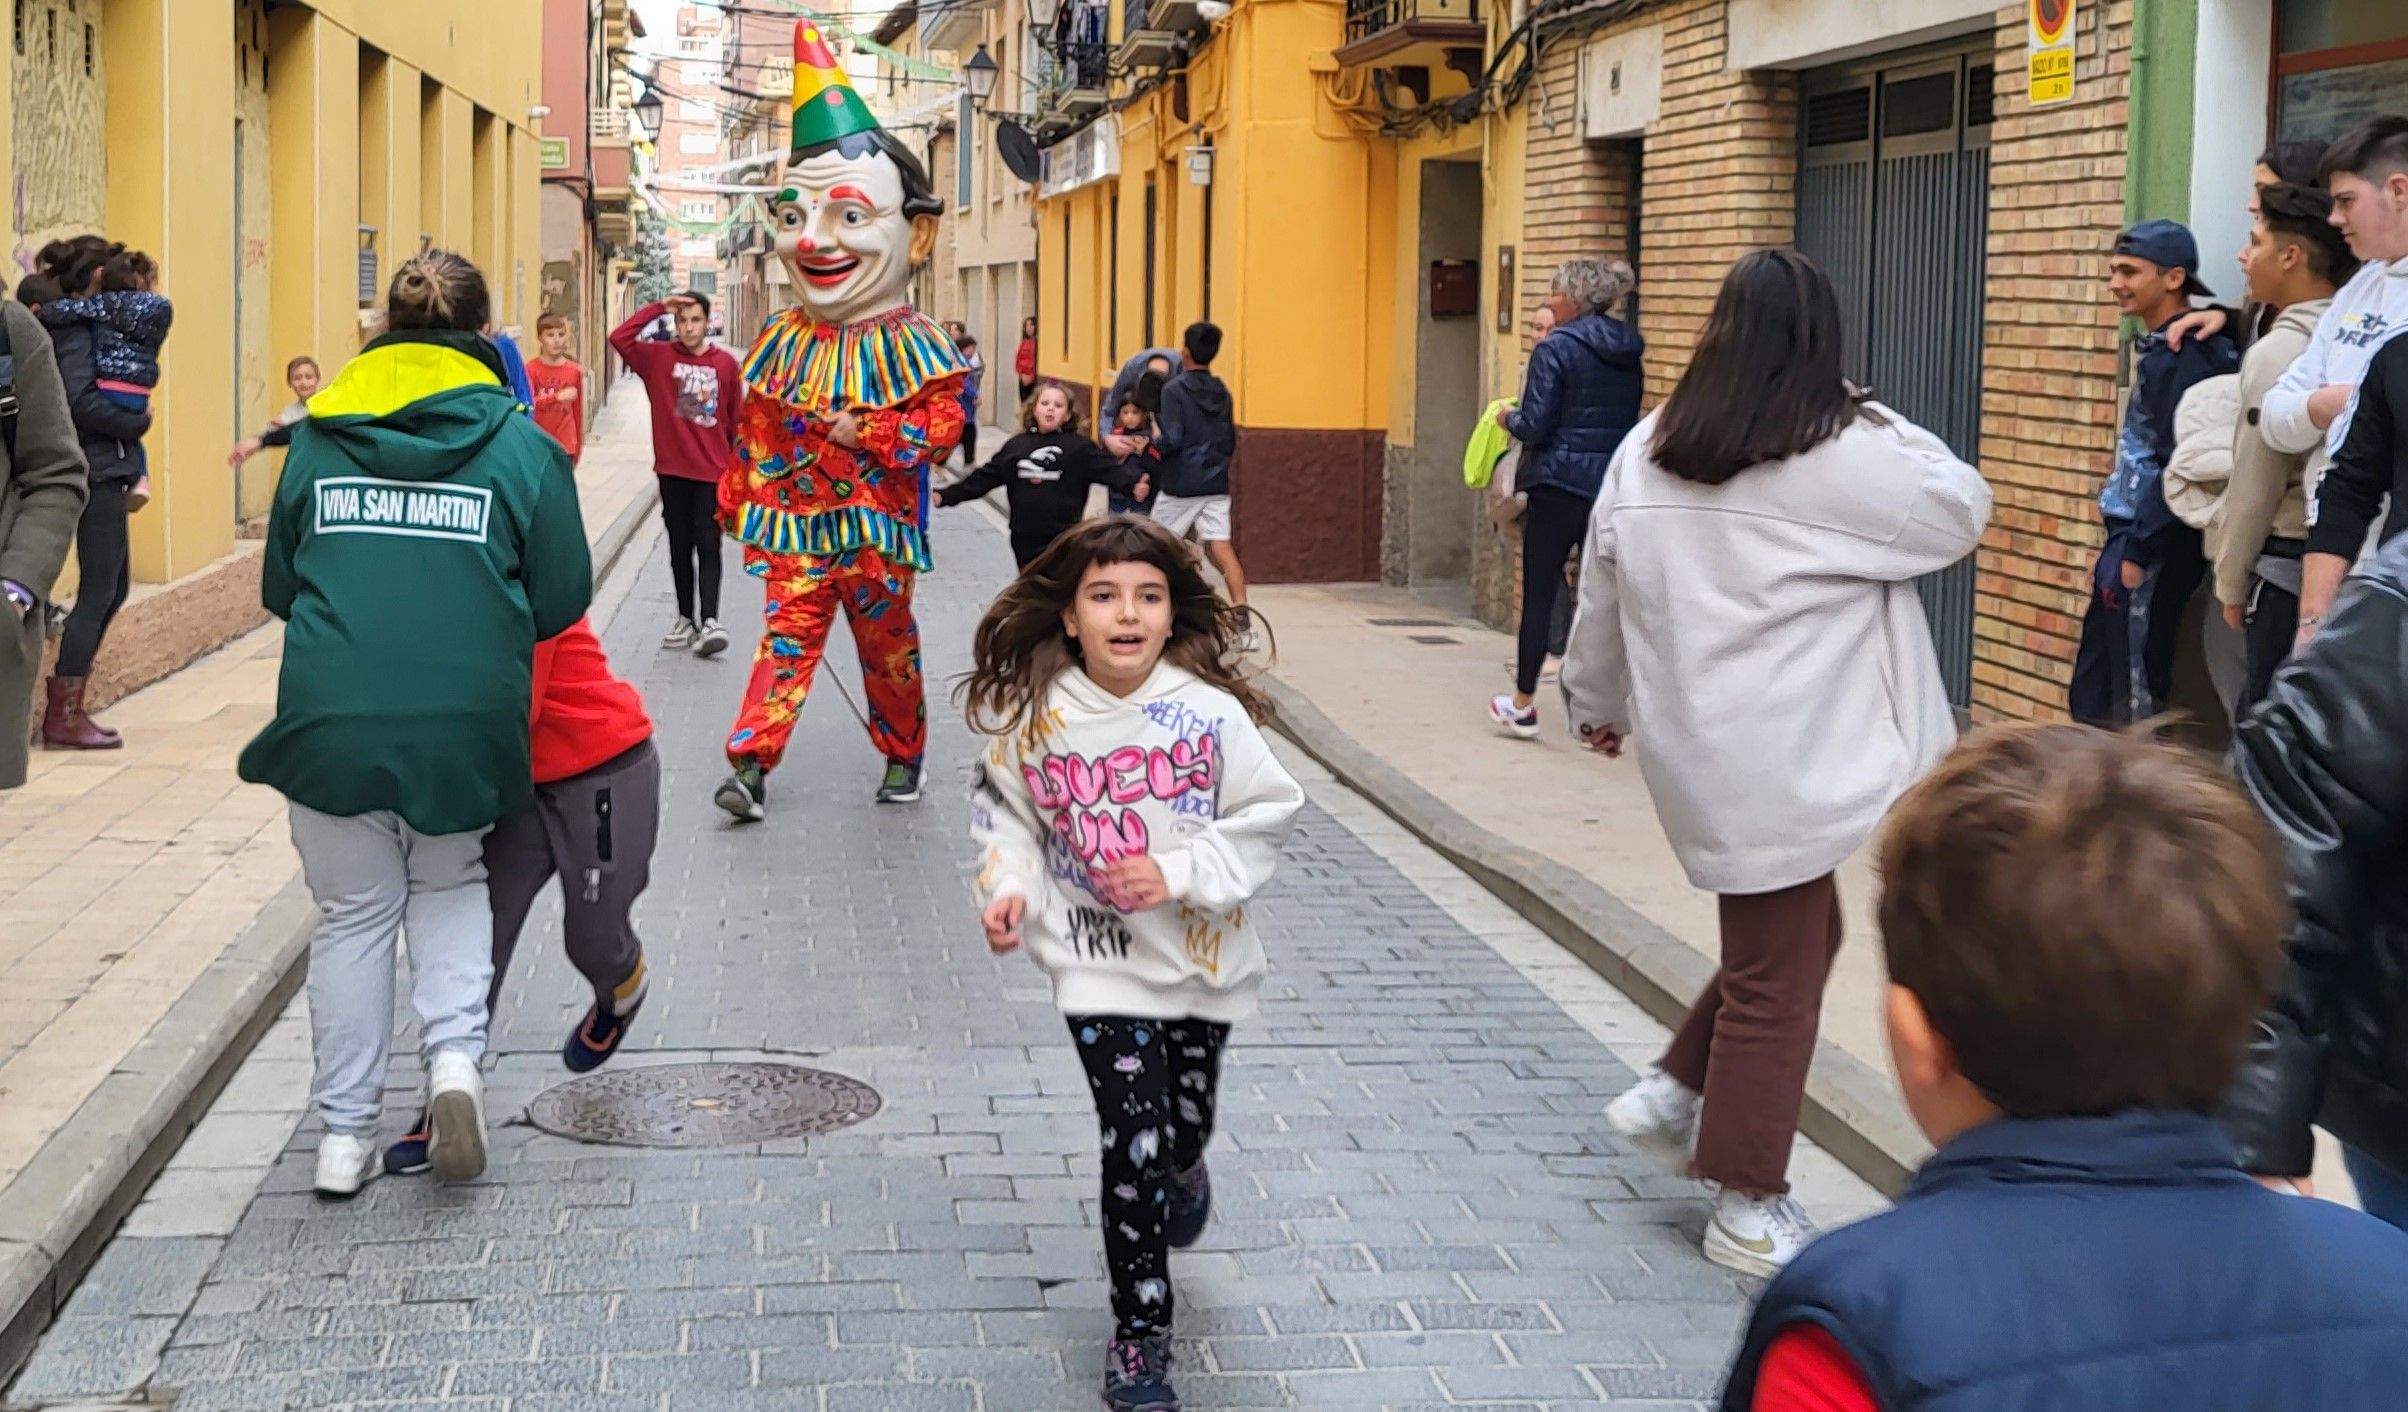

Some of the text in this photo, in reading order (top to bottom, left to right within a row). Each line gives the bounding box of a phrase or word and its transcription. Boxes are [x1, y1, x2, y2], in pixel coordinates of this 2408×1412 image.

[323, 488, 481, 531] VIVA SAN MARTIN
